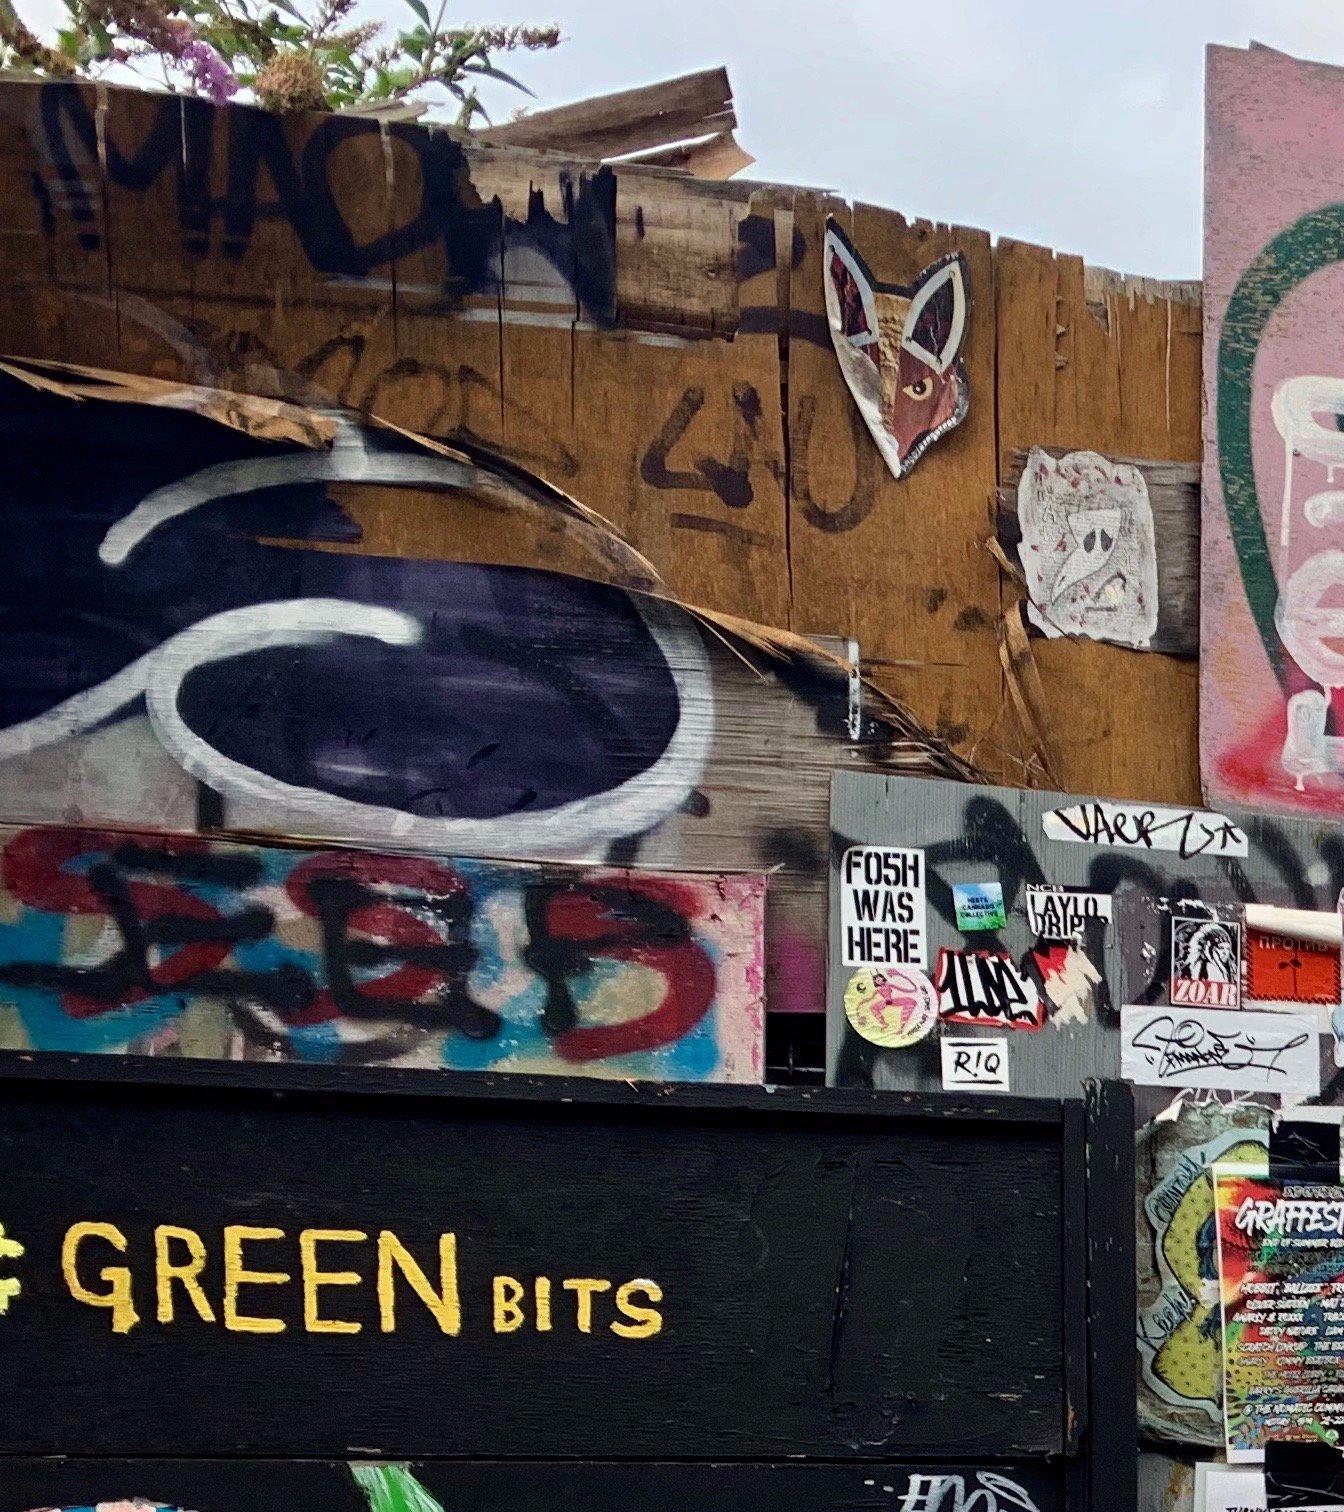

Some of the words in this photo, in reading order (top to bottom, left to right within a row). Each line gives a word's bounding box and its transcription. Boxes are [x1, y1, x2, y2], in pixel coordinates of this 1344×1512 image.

[853, 891, 914, 923] WAS
[847, 927, 921, 963] HERE
[61, 1221, 463, 1336] GREEN
[492, 1276, 663, 1340] BITS
